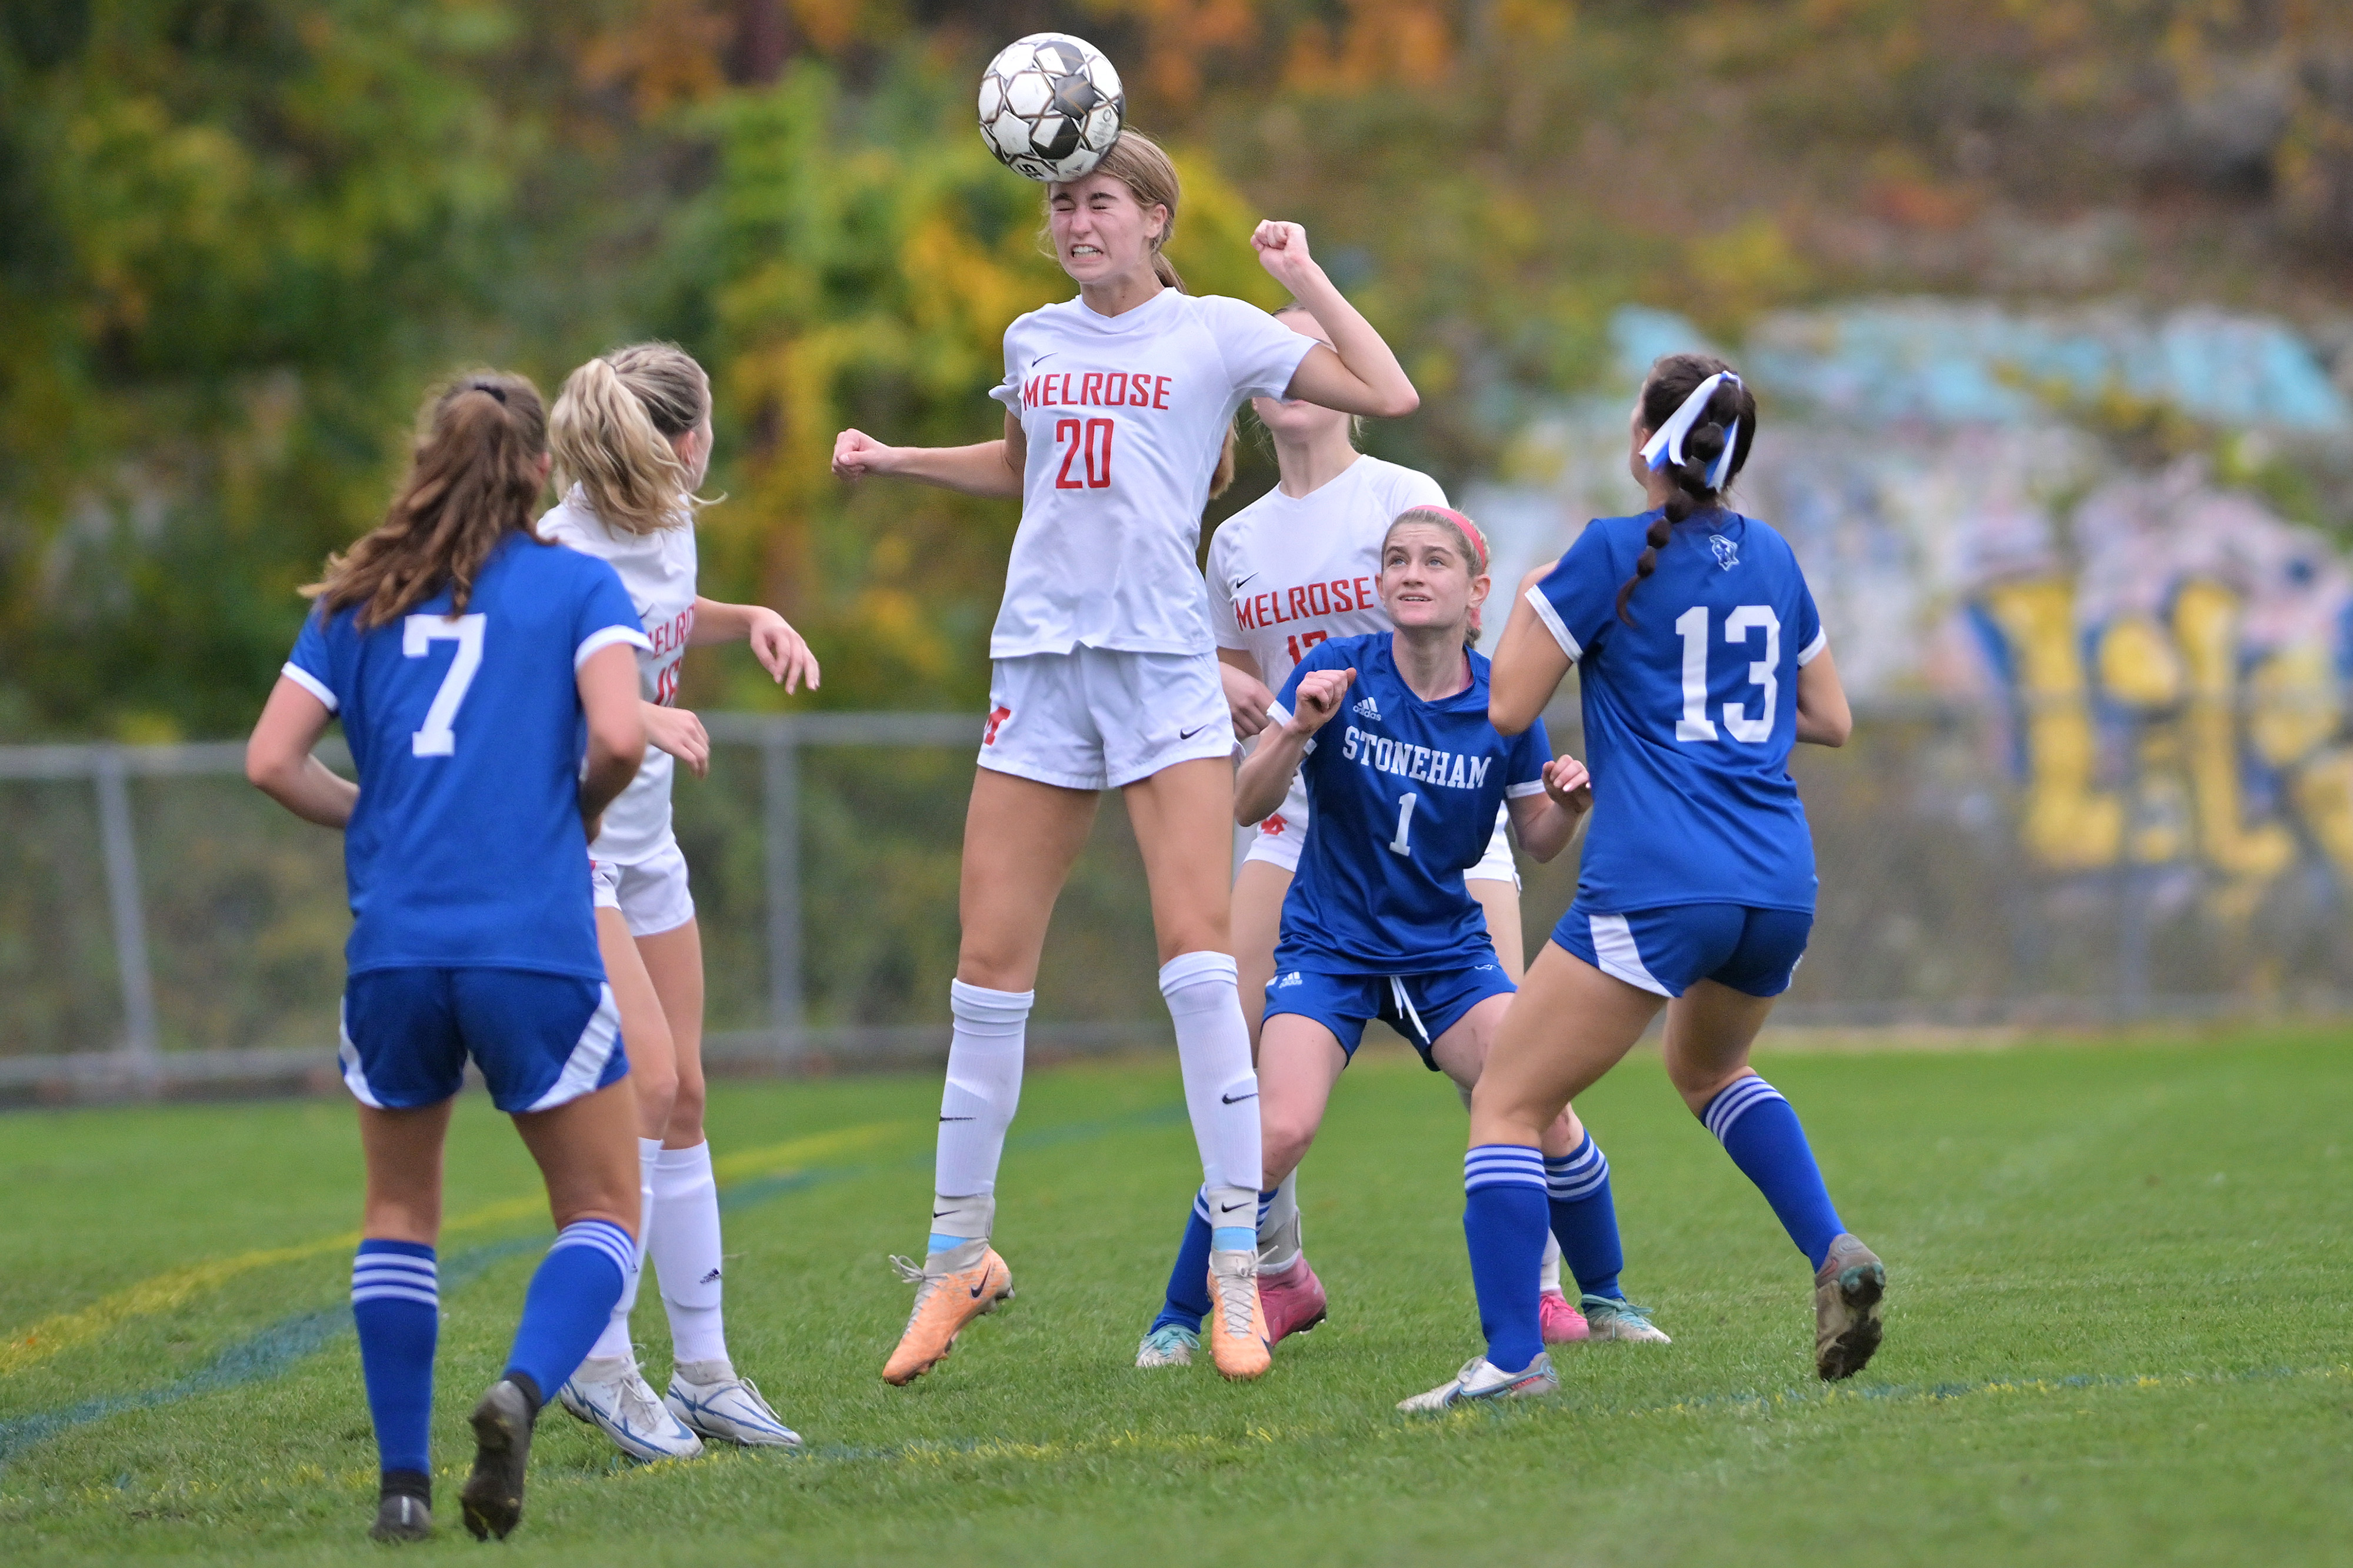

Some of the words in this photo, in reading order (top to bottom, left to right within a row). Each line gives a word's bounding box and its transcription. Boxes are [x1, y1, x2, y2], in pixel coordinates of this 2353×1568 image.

[1023, 372, 1172, 411] MELROSE
[1055, 418, 1115, 489] 20
[1235, 576, 1374, 631] MELROSE
[402, 612, 486, 758] 7
[1675, 605, 1781, 742] 13
[1352, 705, 1381, 722] adidas
[1342, 725, 1491, 789] STONEHAM
[1389, 792, 1417, 856] 1
